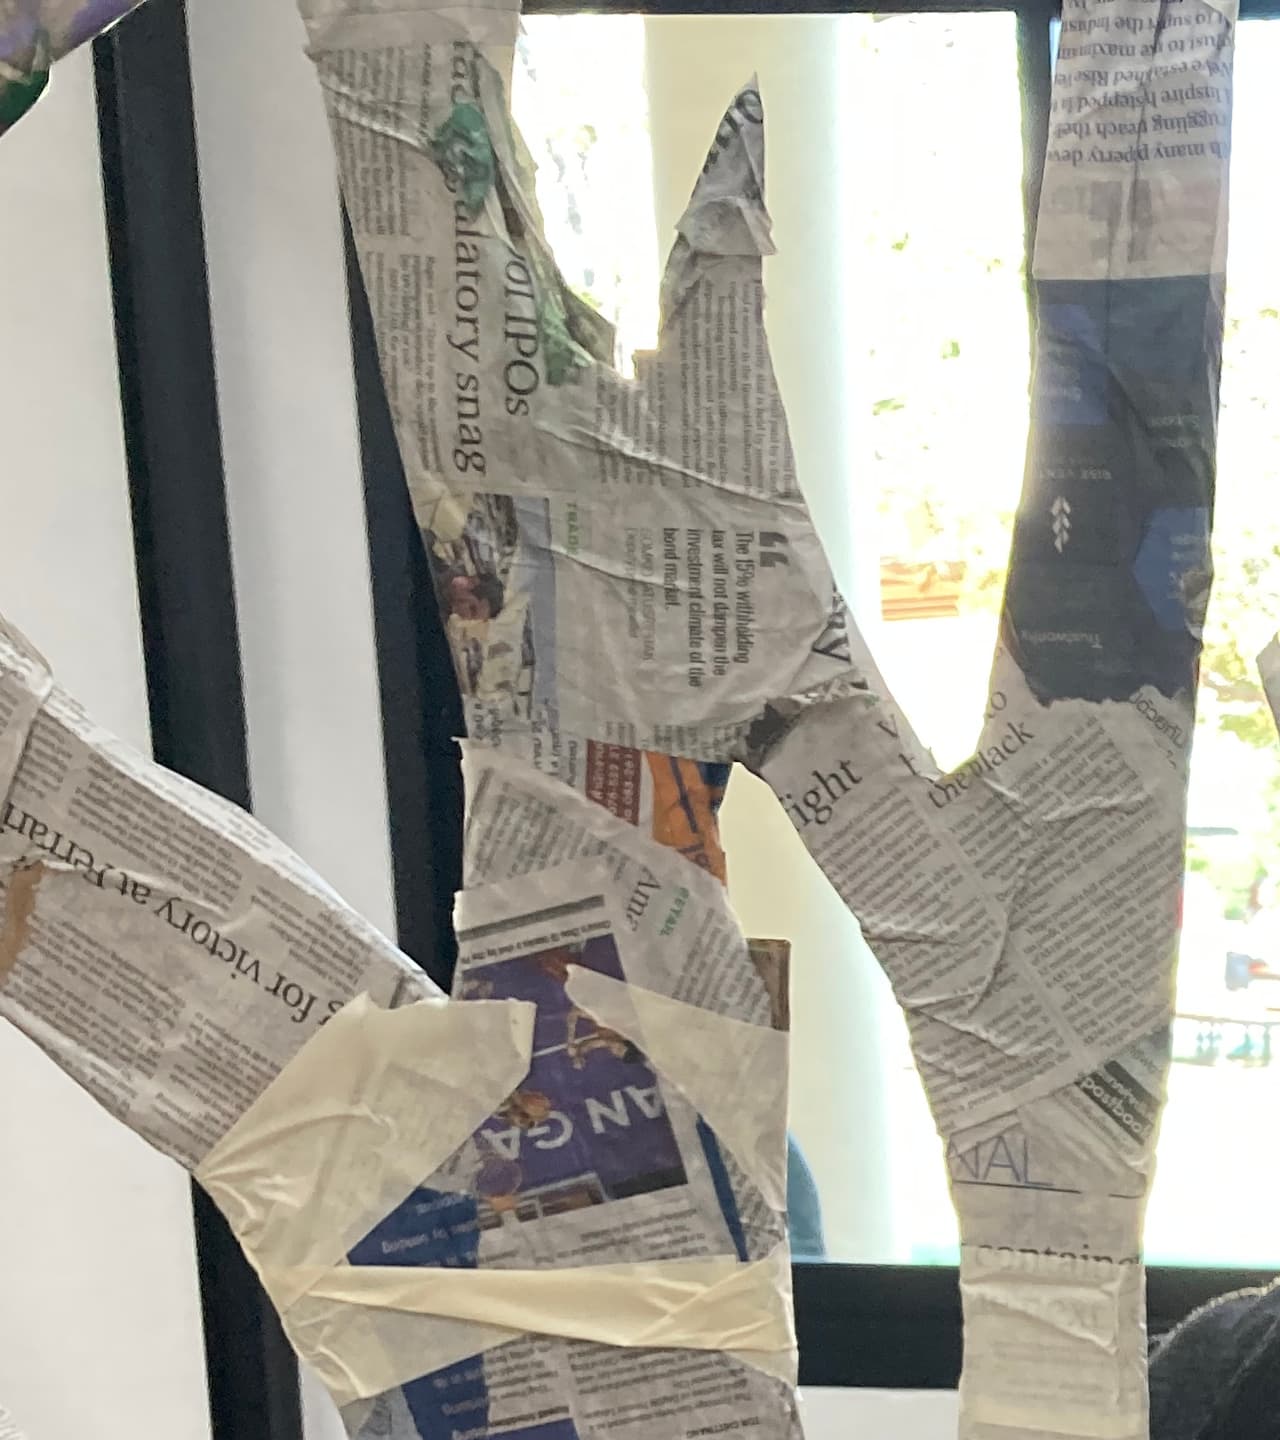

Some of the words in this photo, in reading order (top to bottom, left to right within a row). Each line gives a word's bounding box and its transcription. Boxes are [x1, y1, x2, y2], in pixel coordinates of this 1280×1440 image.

[445, 184, 482, 359] ulatory
[497, 308, 543, 418] IPOs
[446, 371, 491, 477] snag
[661, 527, 681, 559] bond
[710, 529, 727, 549] tax
[734, 531, 753, 554] The
[684, 528, 704, 598] investment
[710, 552, 728, 573] will
[734, 558, 754, 586] 15%
[711, 576, 728, 598] not
[686, 601, 706, 648] climate
[708, 601, 731, 651] dampen
[731, 590, 756, 664] withholding
[687, 651, 707, 664] of
[687, 667, 706, 687] the
[712, 655, 730, 676] the
[108, 868, 155, 908] at
[151, 892, 263, 986] victory
[264, 969, 318, 1022] for
